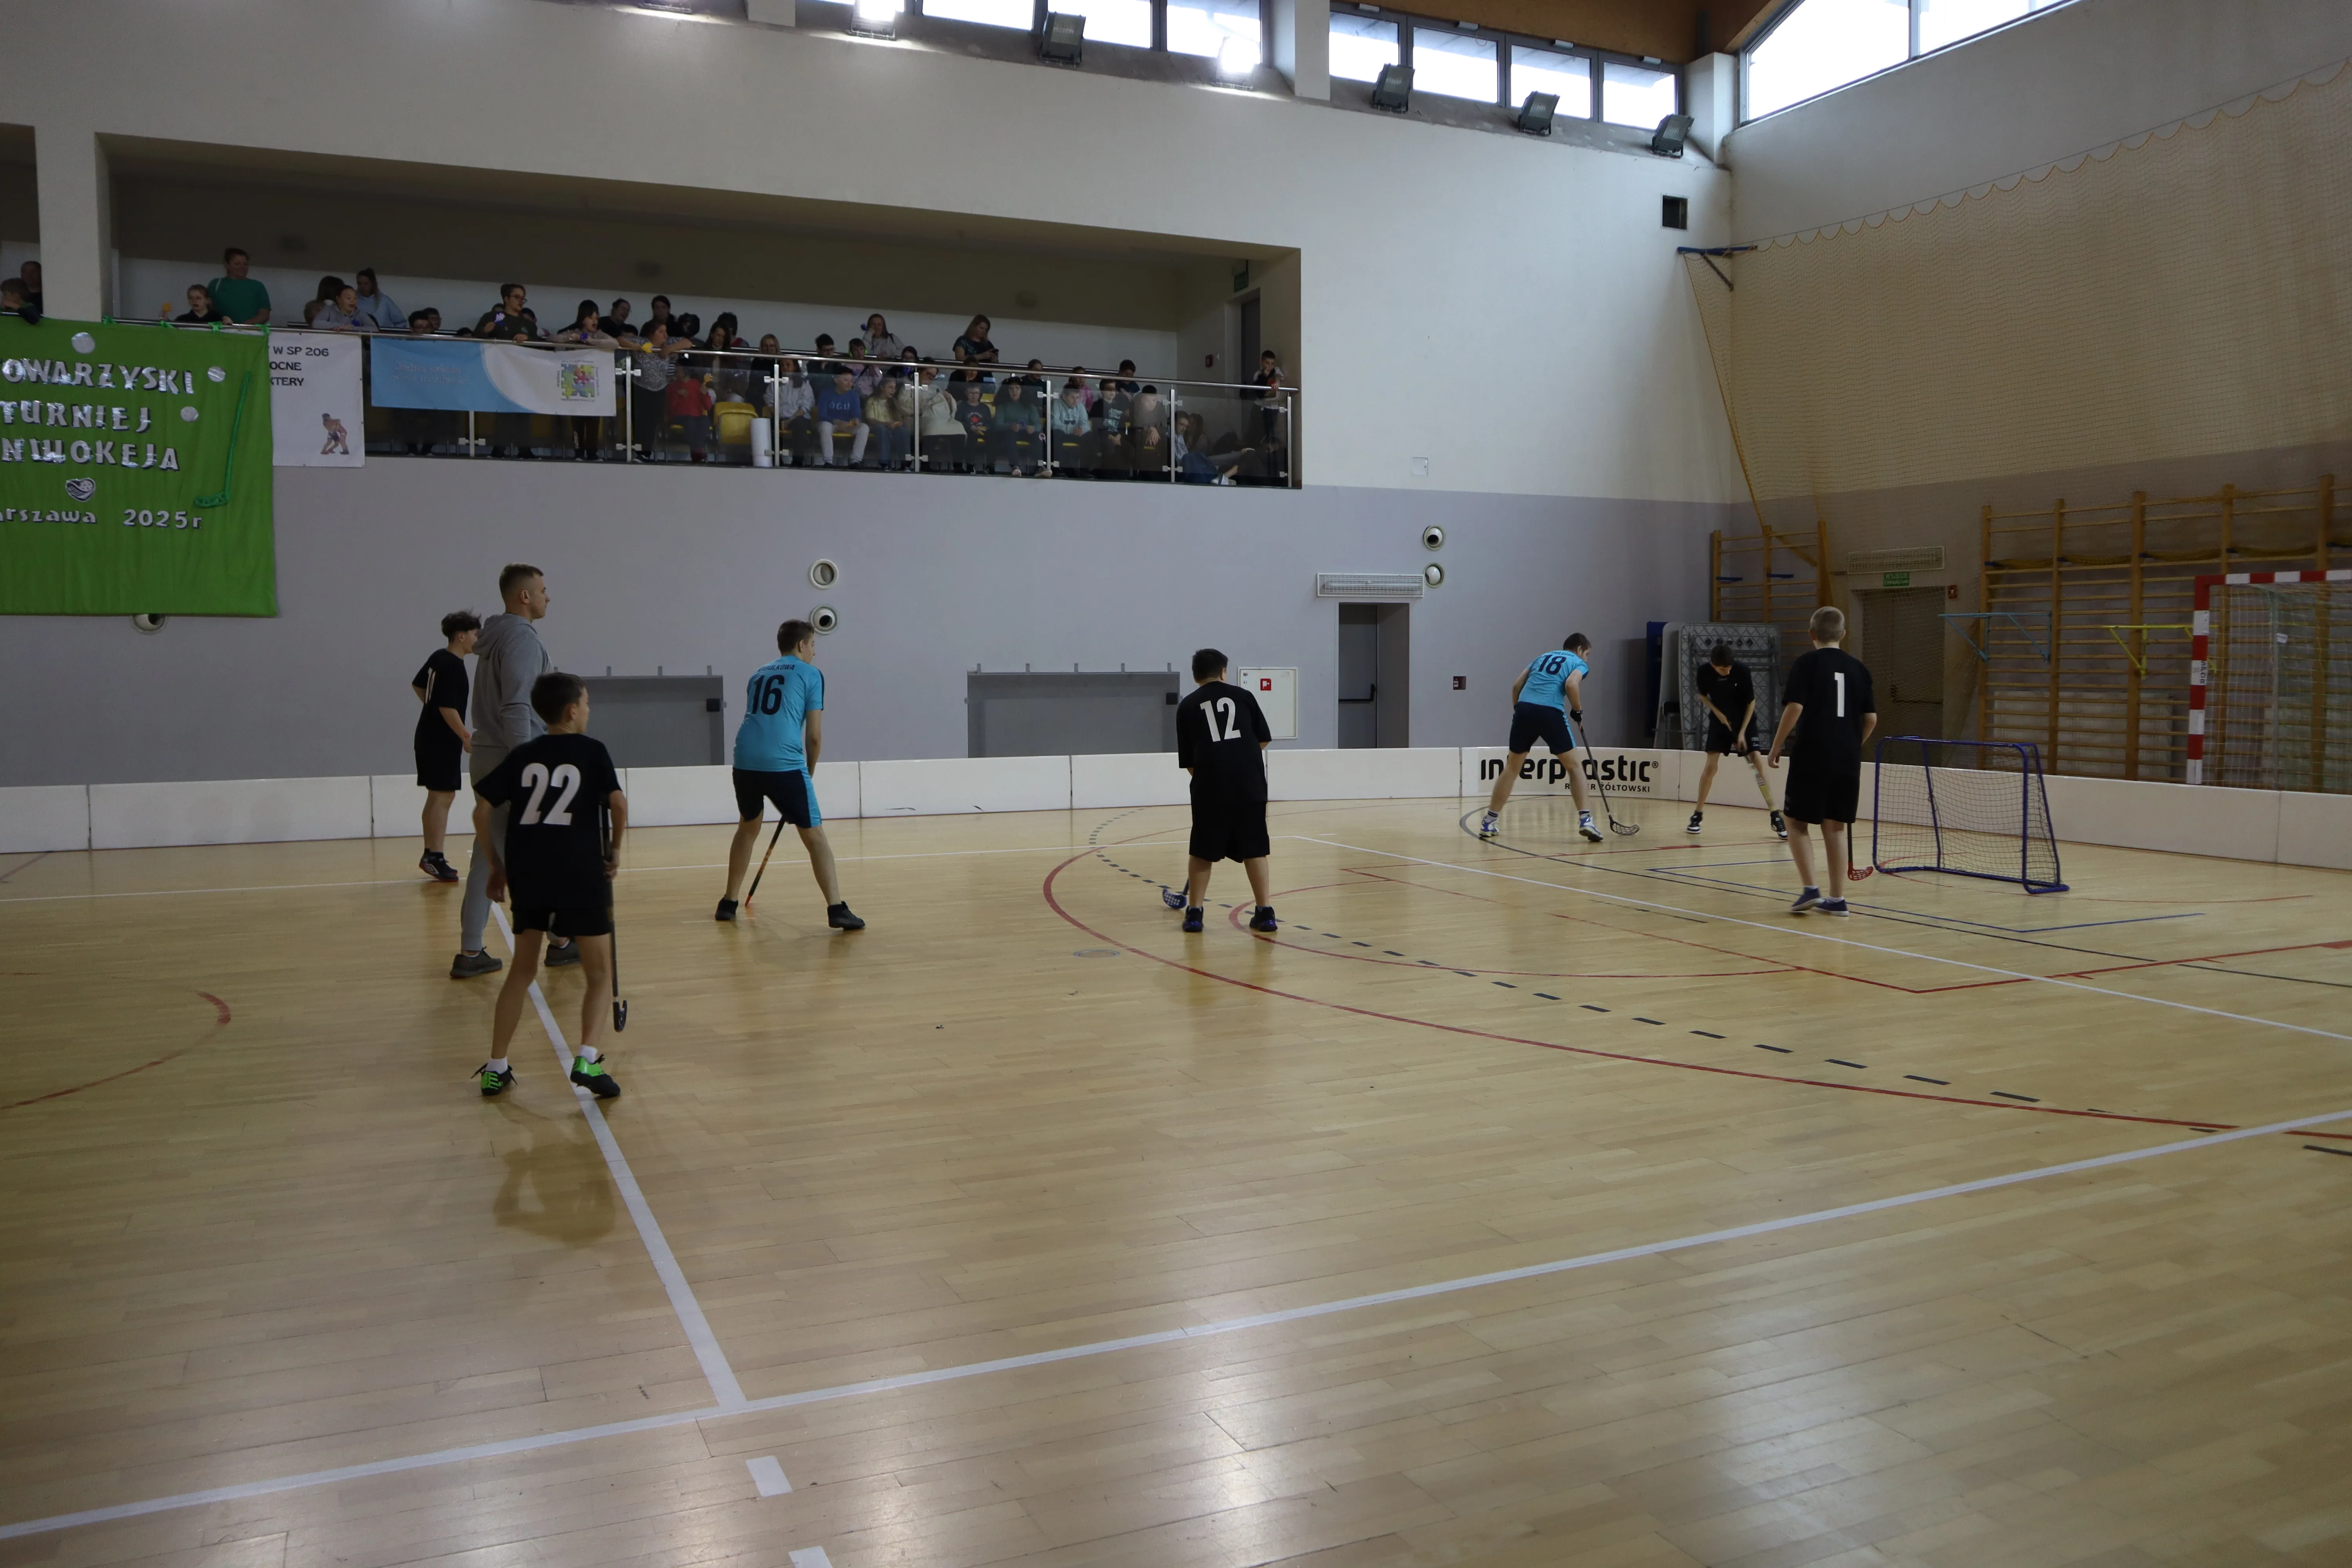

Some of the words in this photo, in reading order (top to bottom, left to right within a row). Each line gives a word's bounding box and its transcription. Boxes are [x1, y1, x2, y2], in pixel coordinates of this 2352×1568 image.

[273, 345, 283, 354] W
[287, 346, 302, 355] SP
[305, 347, 329, 357] 206
[0, 358, 194, 395] OWARZYSKI
[0, 400, 151, 433] TURNIEJ
[0, 508, 96, 524] rszawa
[1537, 654, 1567, 675] 18
[751, 674, 785, 715] 16
[1834, 672, 1845, 717] 1
[1200, 697, 1241, 742] 12
[1481, 755, 1659, 784] inerpastic®
[519, 762, 581, 826] 22
